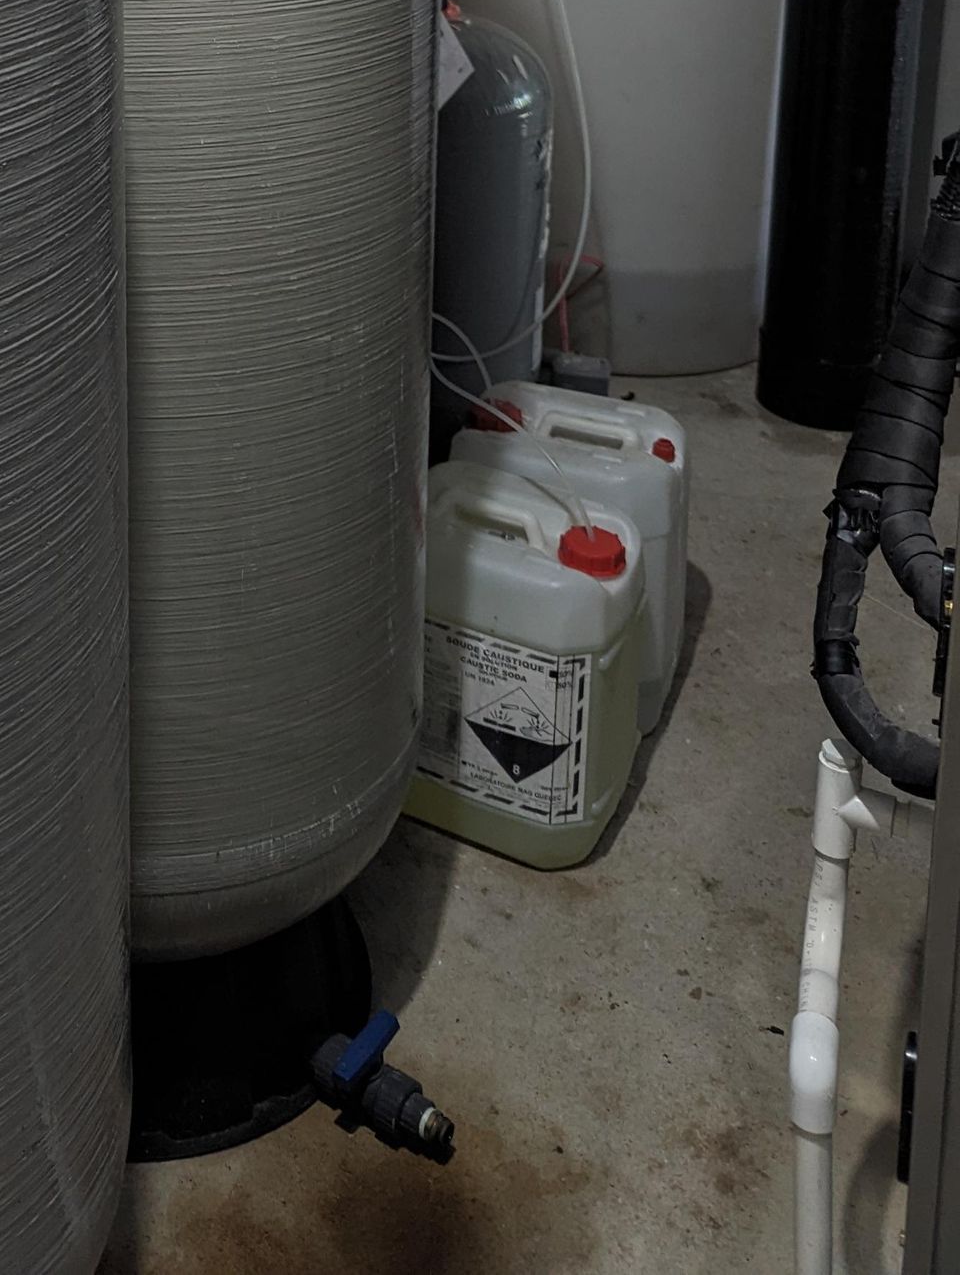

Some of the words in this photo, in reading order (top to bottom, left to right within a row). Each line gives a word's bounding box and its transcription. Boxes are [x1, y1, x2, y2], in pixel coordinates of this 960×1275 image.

[446, 636, 480, 654] SOUDE
[483, 649, 544, 673] CAUSTIQUE
[460, 656, 499, 674] CAUSTIC
[502, 669, 527, 683] SODA
[512, 764, 520, 775] 8
[809, 896, 819, 932] ASTM
